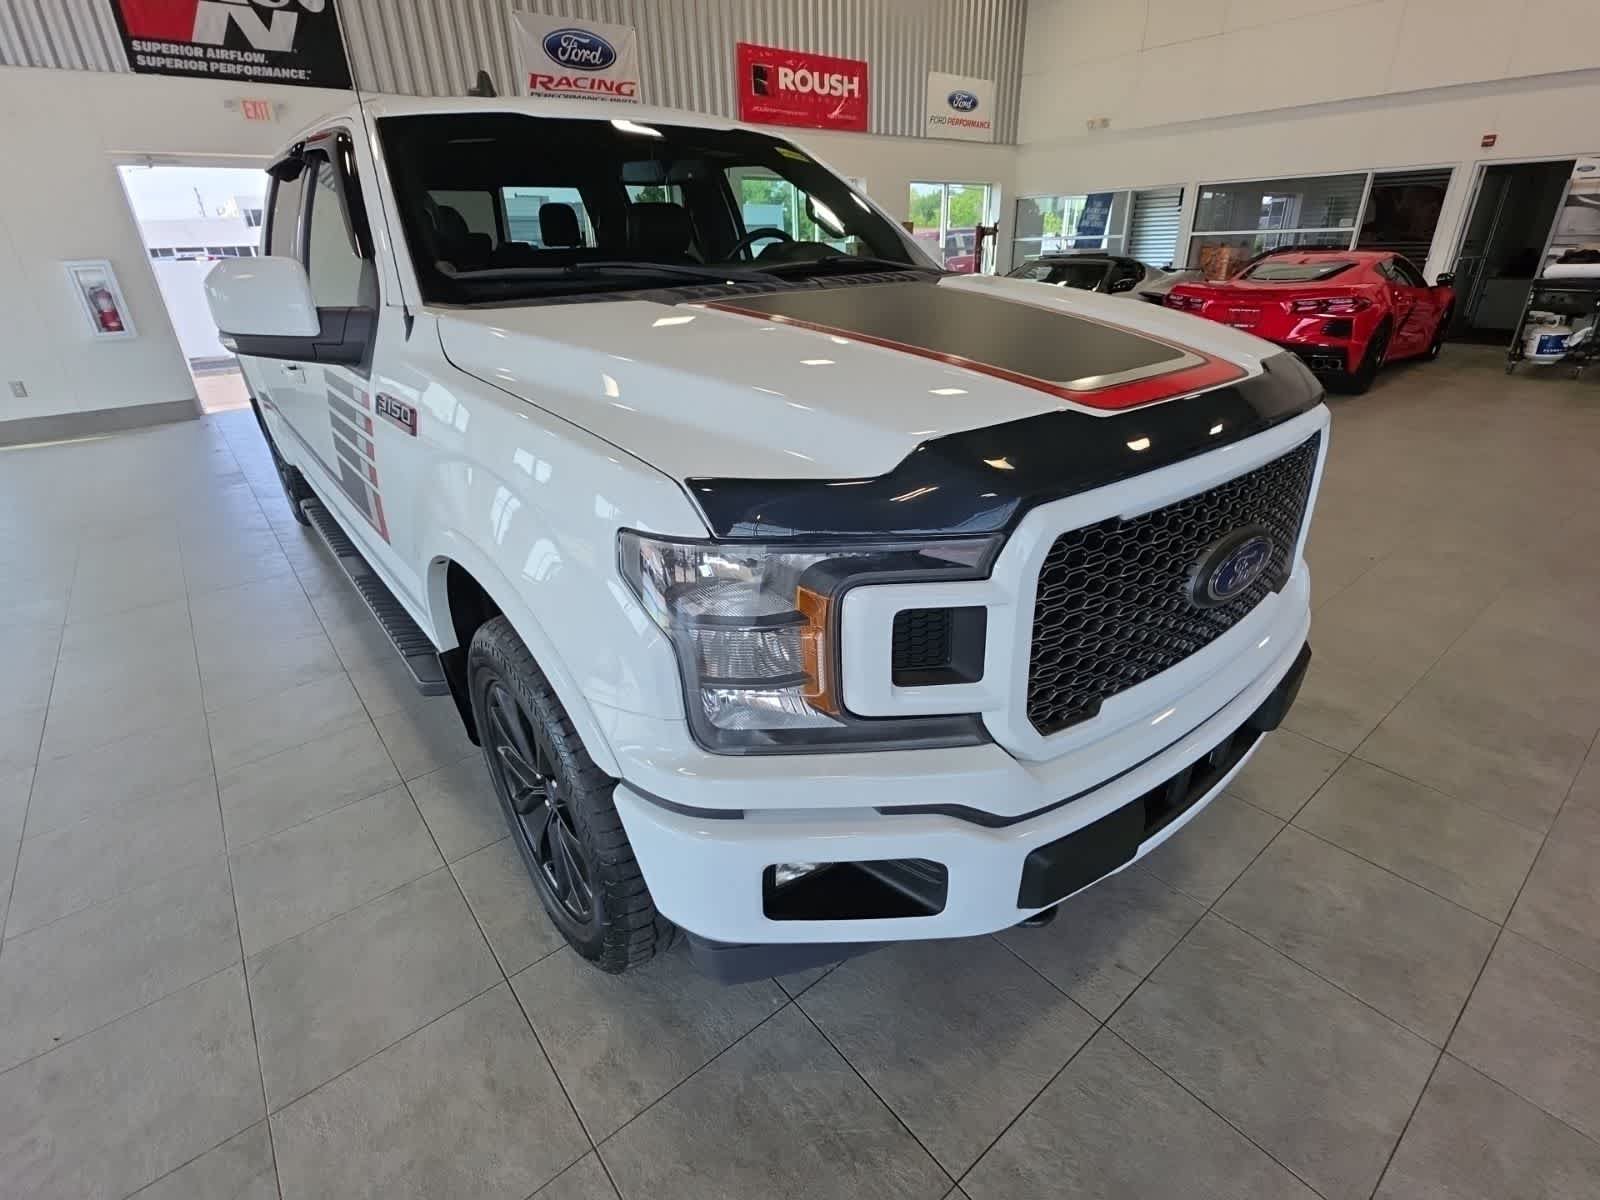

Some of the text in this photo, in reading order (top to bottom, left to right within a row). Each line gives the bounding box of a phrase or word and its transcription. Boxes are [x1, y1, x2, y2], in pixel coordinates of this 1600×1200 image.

[131, 39, 269, 65] SUPERIOR AIRFLOW.
[558, 34, 603, 64] Ford
[136, 54, 208, 72] SUPERIOR
[529, 73, 637, 97] RACING
[777, 66, 860, 98] ROUSH
[241, 100, 270, 120] EXIT
[952, 94, 973, 109] Ford
[929, 114, 991, 129] FORD PERFORMANCE
[1227, 550, 1265, 588] Ford
